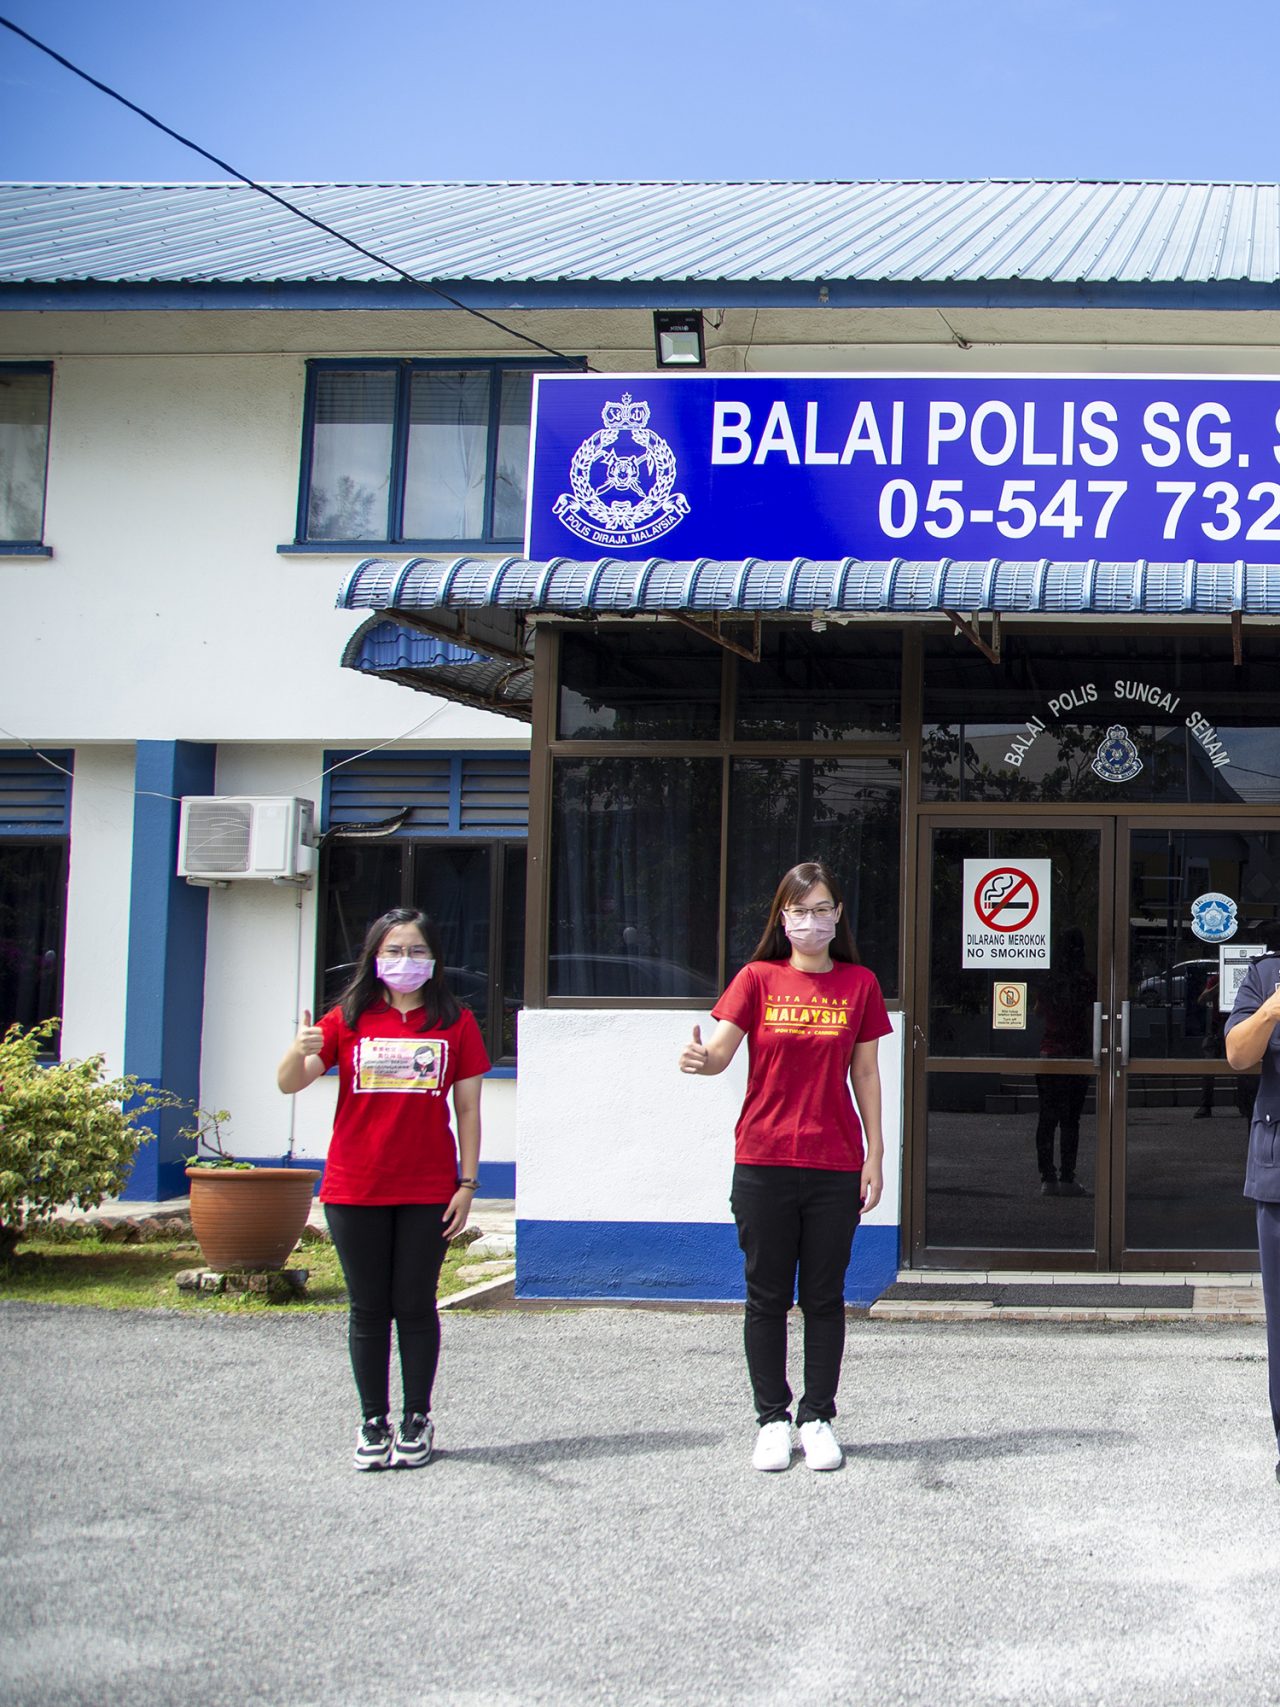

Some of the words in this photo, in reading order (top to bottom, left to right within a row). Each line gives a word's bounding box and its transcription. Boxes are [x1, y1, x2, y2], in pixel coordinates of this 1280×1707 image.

[711, 401, 904, 465] BALAI
[928, 401, 1119, 467] POLIS
[1141, 401, 1250, 468] SG.
[878, 478, 1128, 539] 05-547
[565, 514, 591, 537] POLIS
[592, 530, 628, 544] DIRAJA
[631, 514, 677, 543] MALAYSIA
[1003, 715, 1046, 767] BALAI
[1047, 683, 1098, 717] POLIS
[1114, 680, 1180, 714] SUNGAI
[1185, 711, 1231, 769] SENAM
[967, 934, 1005, 946] DILARANG
[1008, 934, 1046, 946] MEROKOK
[967, 948, 984, 958] NO
[990, 948, 1046, 959] SMOKING
[767, 995, 800, 1003] KITA
[811, 996, 848, 1005] ANAK
[765, 1007, 847, 1025] MALAYSIA
